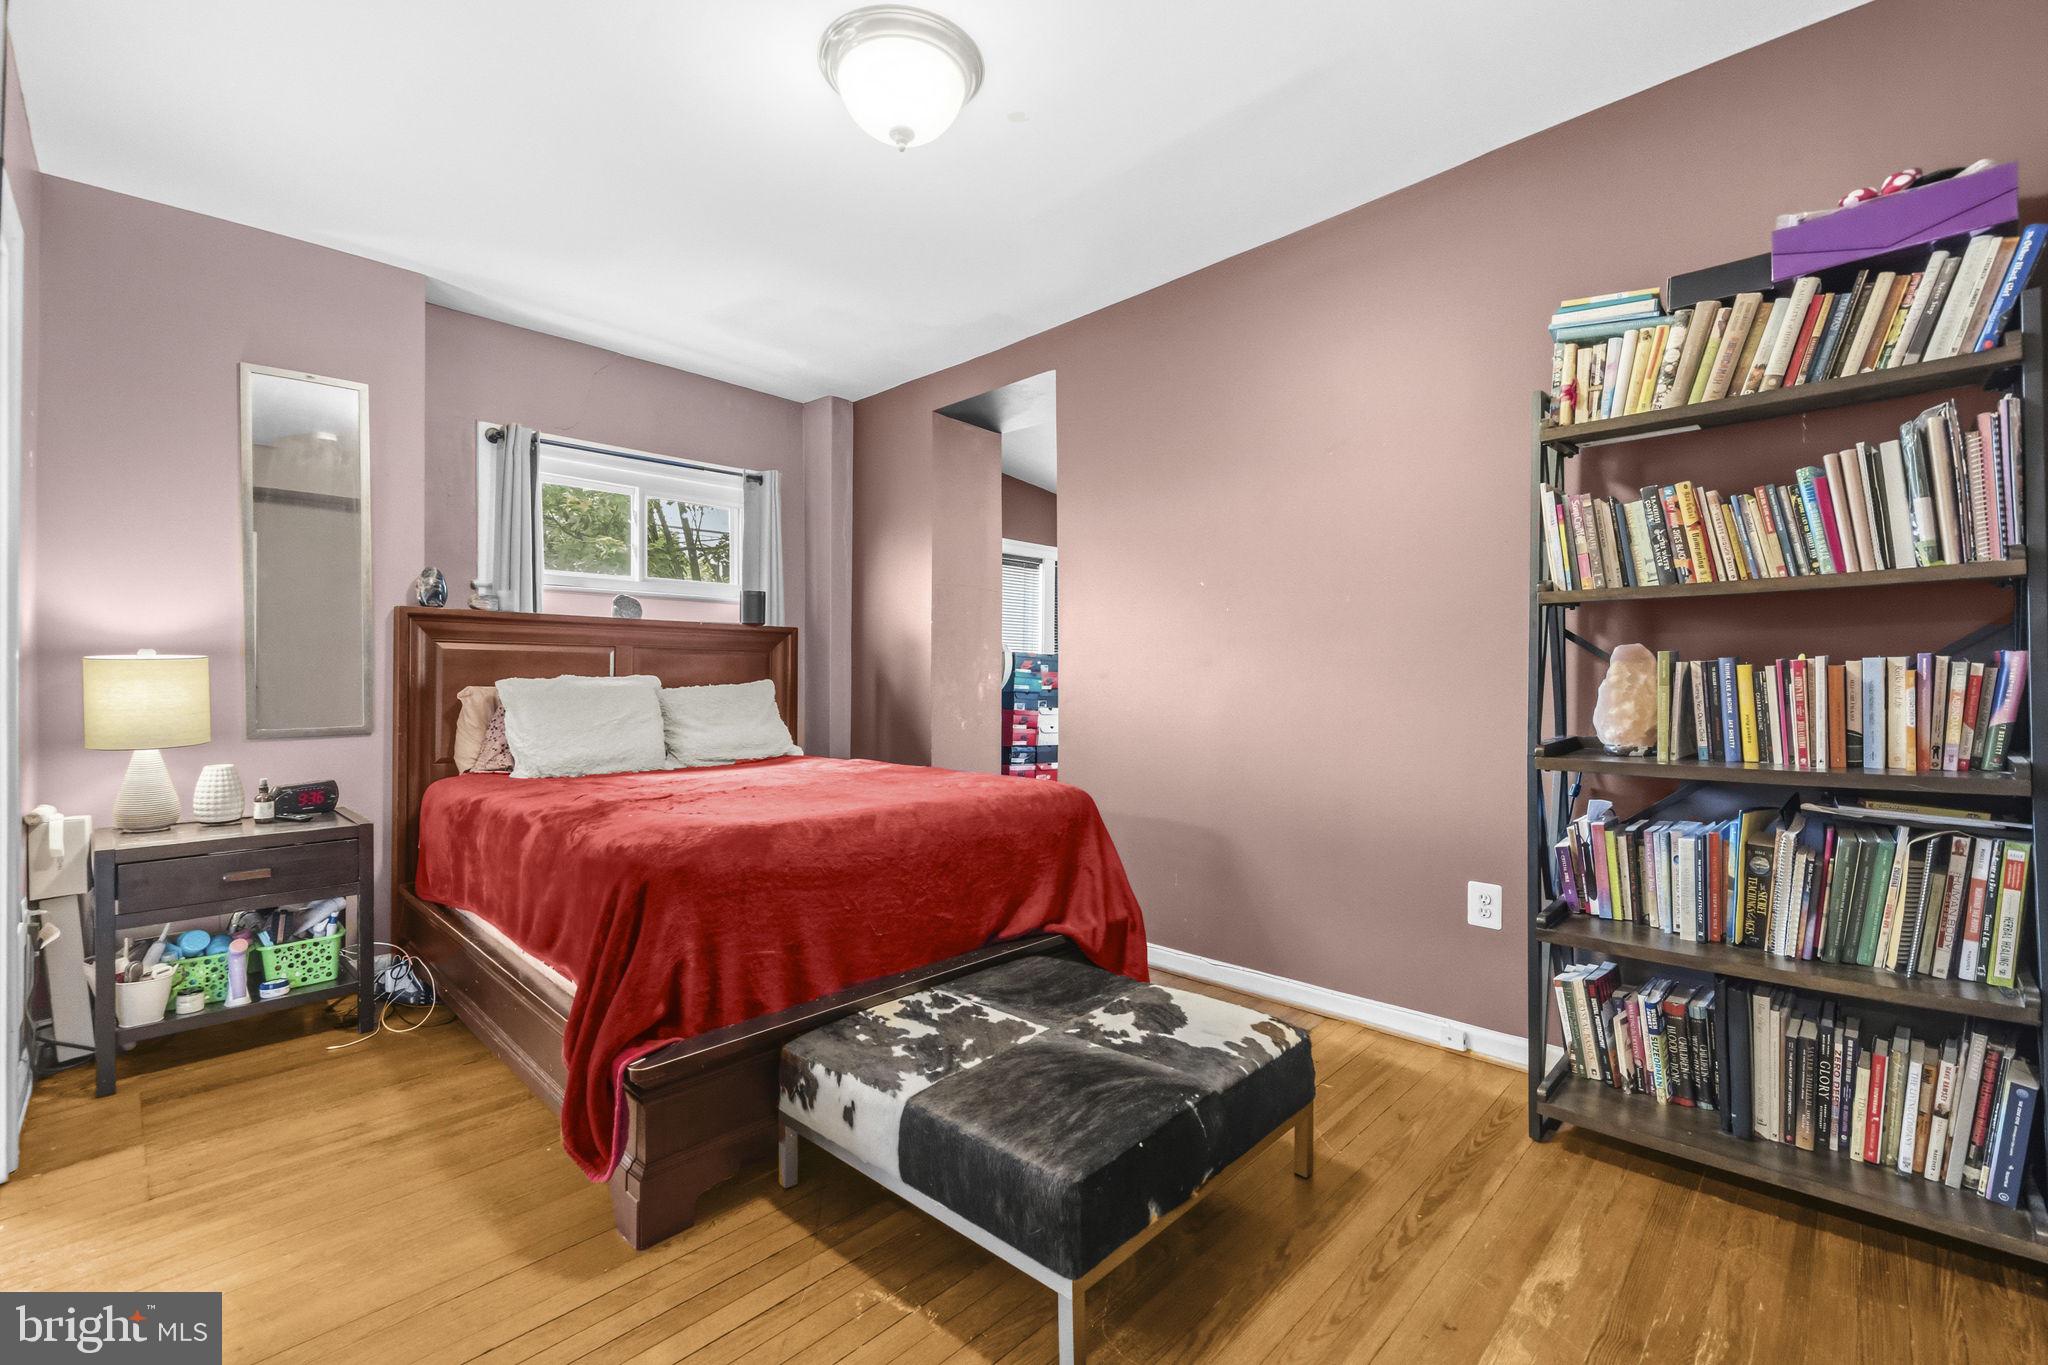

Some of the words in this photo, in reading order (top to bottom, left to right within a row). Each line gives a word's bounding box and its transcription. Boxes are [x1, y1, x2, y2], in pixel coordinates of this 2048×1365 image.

[2017, 238, 2033, 261] Other
[2007, 259, 2023, 282] Black
[2001, 280, 2014, 298] Girl
[1653, 544, 1663, 567] DANCER
[1660, 549, 1670, 571] WATER
[1723, 662, 1731, 679] THINK
[1894, 664, 1902, 682] Reiki
[1724, 680, 1732, 691] LIKE
[1894, 684, 1902, 694] for
[1728, 728, 1736, 749] SHETTY
[1745, 877, 1757, 912] TEACHINGS
[1756, 890, 1767, 915] SECRET
[1947, 876, 1963, 916] HUMAN
[1744, 918, 1755, 935] AGES
[1942, 919, 1956, 949] BODY
[2001, 916, 2014, 939] HERBAL
[1998, 940, 2011, 966] HEALING
[1666, 1024, 1677, 1053] BLOOD
[1677, 1036, 1689, 1072] CHILDREN
[1698, 1044, 1709, 1076] CHILDREN
[1833, 1050, 1841, 1078] ZERO
[1670, 1061, 1681, 1086] BONE
[1817, 1060, 1831, 1100] GLORY
[1909, 1072, 1919, 1086] THE
[1940, 1080, 1950, 1102] RAMSEY
[1930, 1149, 1938, 1171] MAKEOVER
